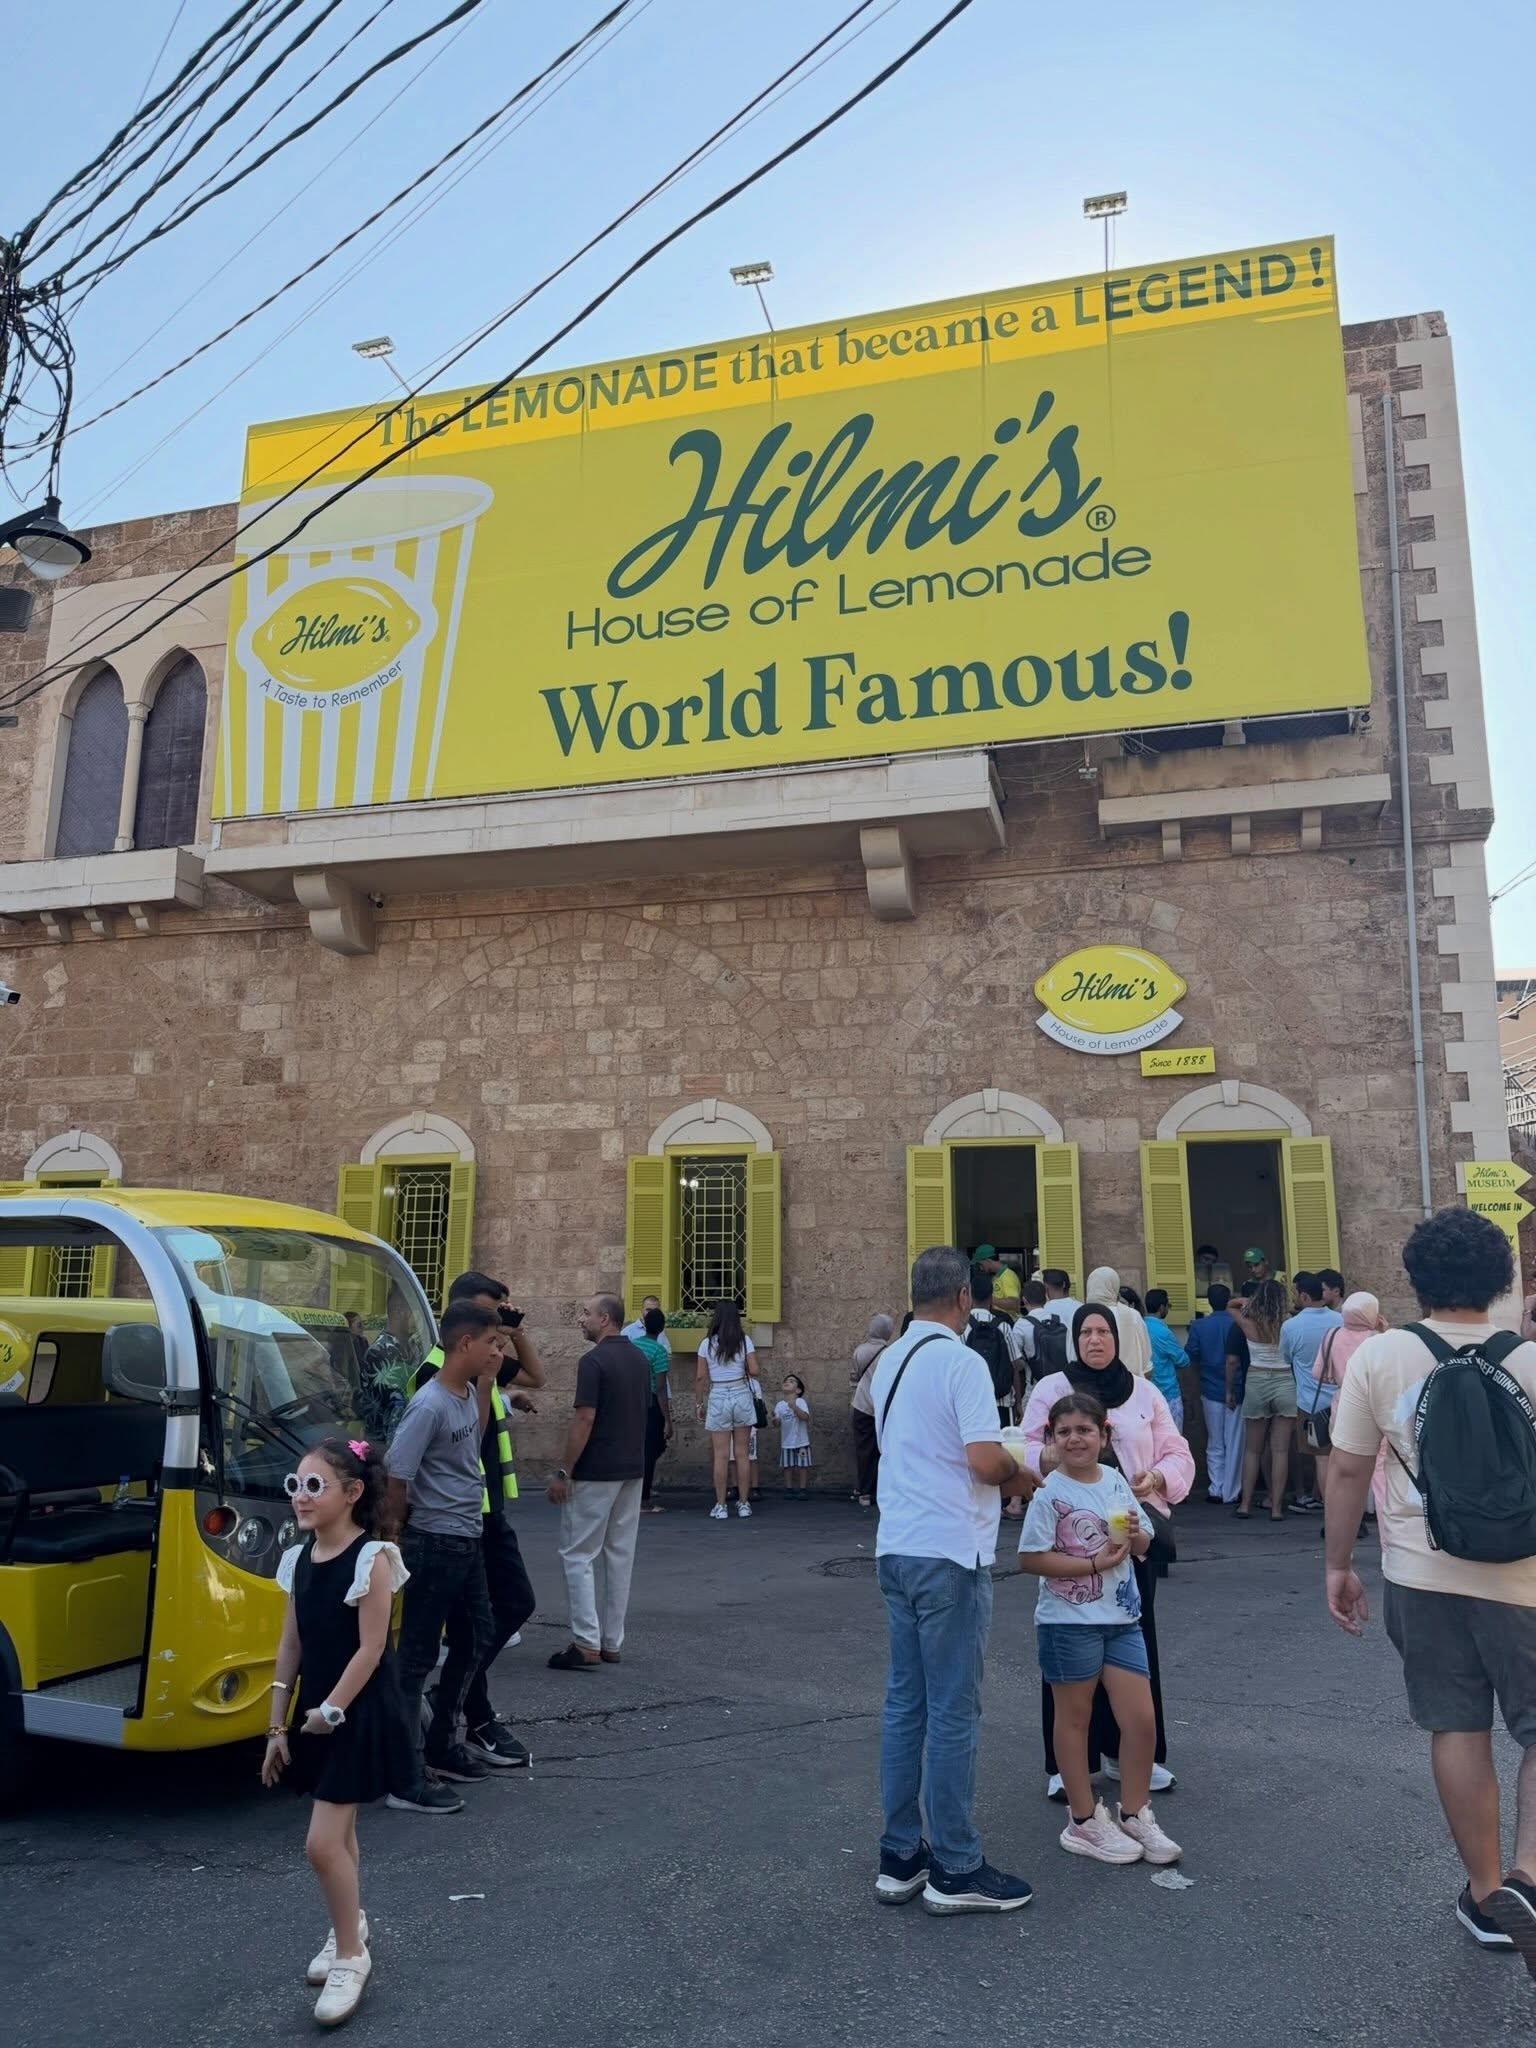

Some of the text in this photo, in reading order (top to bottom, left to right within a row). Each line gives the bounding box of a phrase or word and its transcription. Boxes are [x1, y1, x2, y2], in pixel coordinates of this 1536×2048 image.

[375, 407, 451, 447] The
[462, 352, 718, 432] LEMONADE
[729, 337, 825, 385] that
[836, 307, 1019, 366] became
[1032, 304, 1059, 333] a
[607, 390, 1102, 600] Hilmi's
[566, 538, 1152, 649] House of Lemonade
[280, 613, 389, 656] Hilmi's
[260, 660, 403, 709] A Taste to Remember
[539, 611, 1193, 758] World Famous!
[1061, 971, 1158, 1003] Hilmi's
[1050, 1018, 1169, 1050] House of Lemonade
[1149, 1054, 1207, 1069] Since 1888
[1467, 1179, 1516, 1188] MUSEUM
[1471, 1202, 1523, 1212] WELCOME IN
[1492, 1369, 1520, 1395] GOING
[1515, 1396, 1534, 1420] JUST
